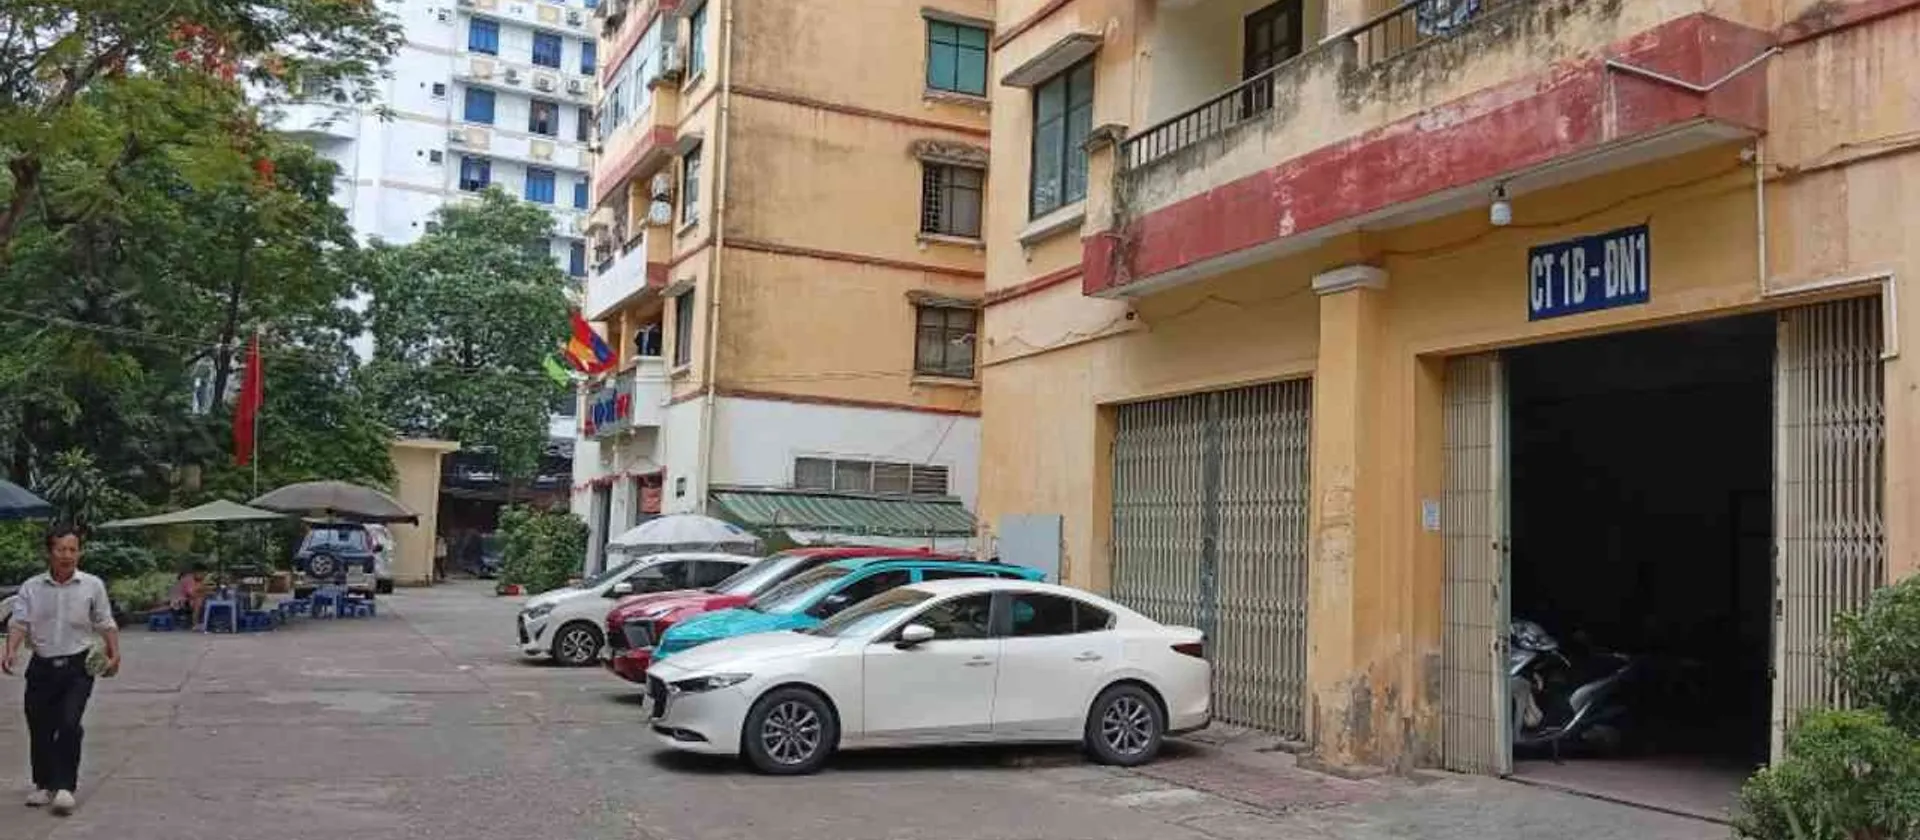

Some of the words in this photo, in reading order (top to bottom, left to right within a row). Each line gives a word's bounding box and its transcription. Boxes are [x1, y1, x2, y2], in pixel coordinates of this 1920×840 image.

[1531, 253, 1554, 312] CT
[1560, 247, 1586, 306] 1B
[1605, 233, 1646, 298] ĐN1
